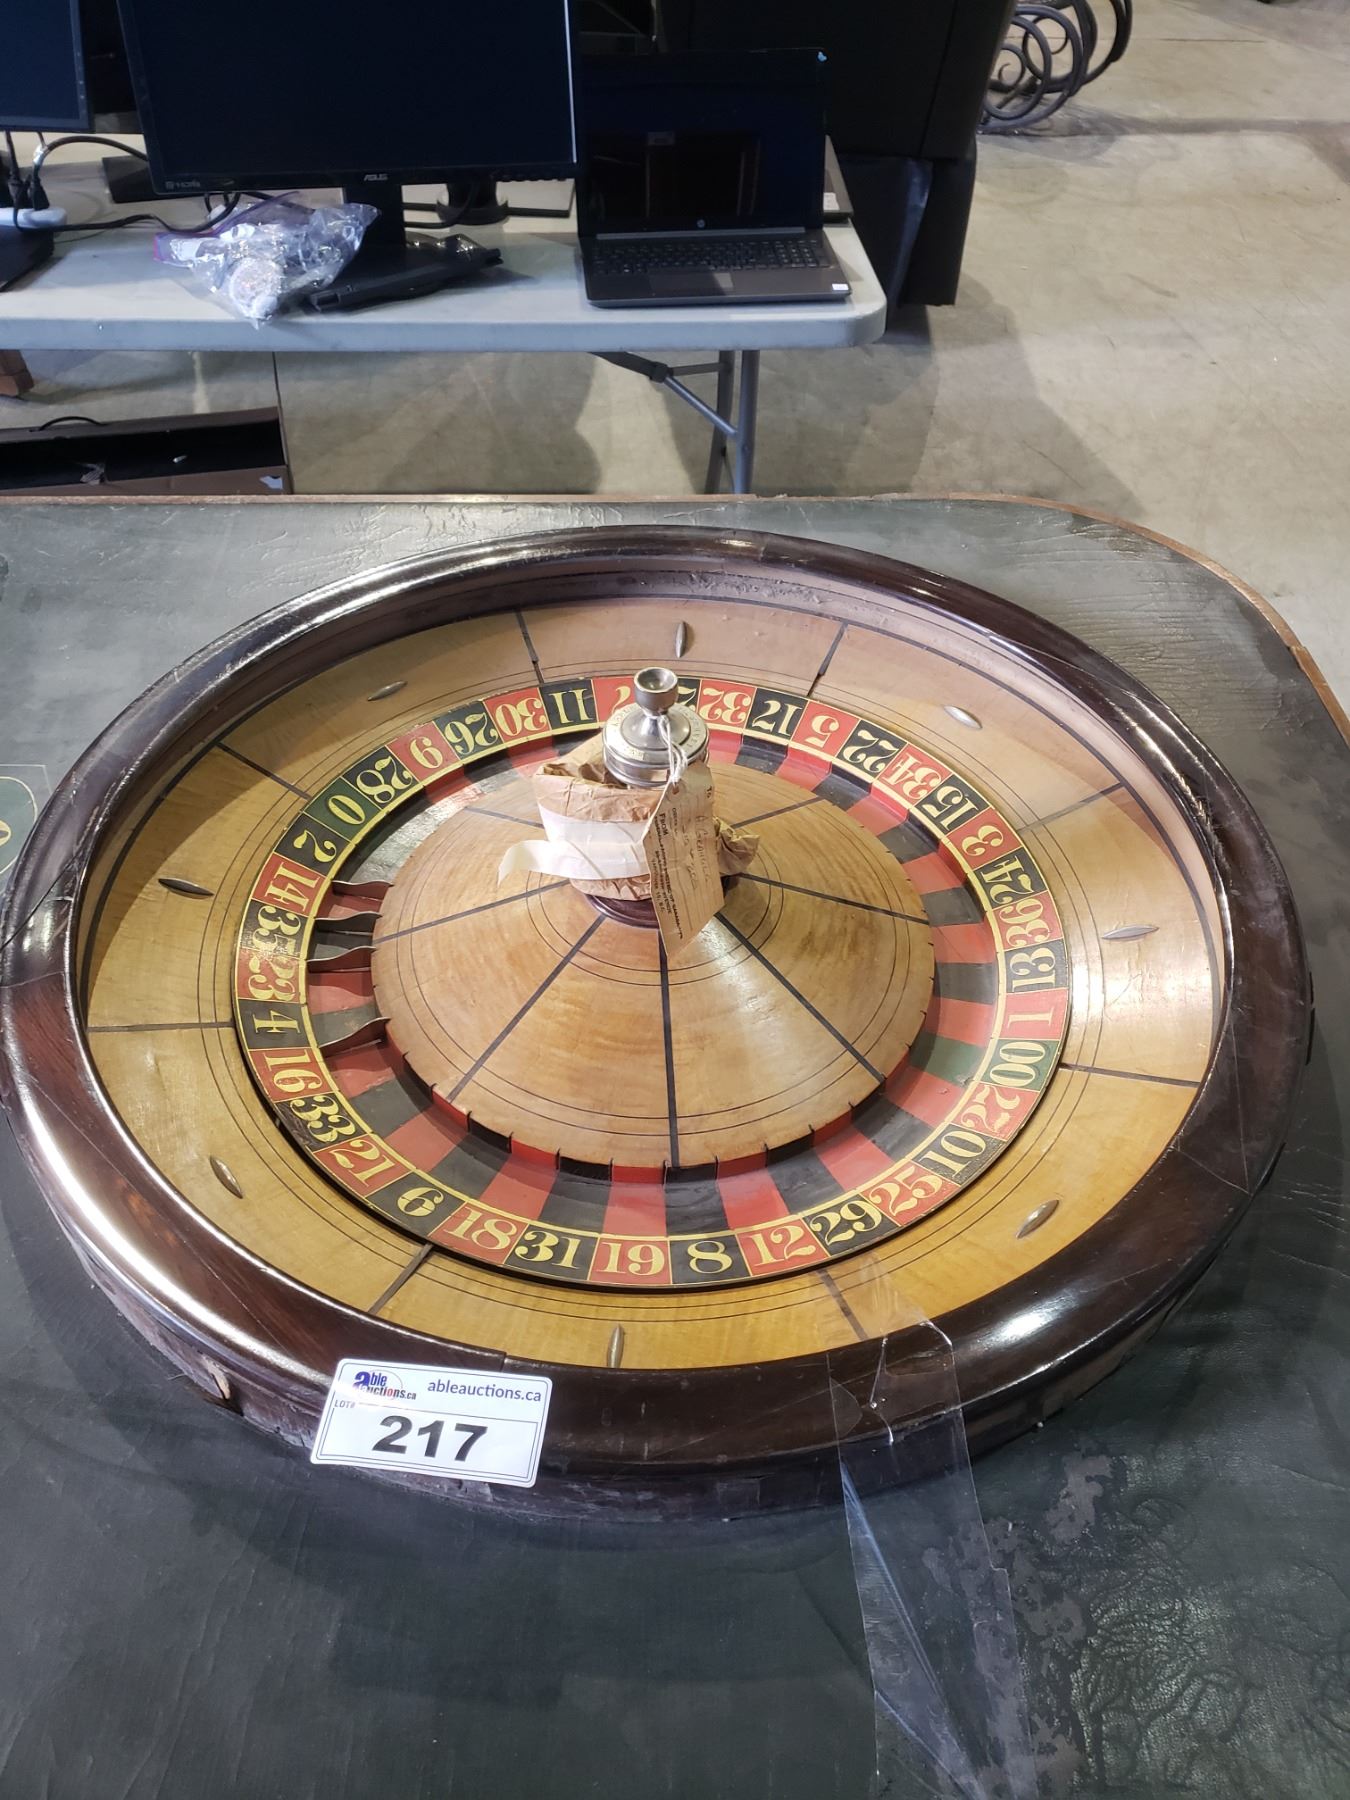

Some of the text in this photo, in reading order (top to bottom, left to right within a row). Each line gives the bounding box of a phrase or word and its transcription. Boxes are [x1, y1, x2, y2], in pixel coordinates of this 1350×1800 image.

[495, 697, 546, 736] 30
[552, 689, 593, 724] 11
[699, 687, 753, 724] 32
[752, 700, 803, 736] 17
[410, 737, 444, 769] 9
[444, 712, 499, 754] 26
[809, 715, 840, 748] 5
[843, 729, 900, 773] 22
[356, 756, 413, 804] 28
[881, 752, 942, 800] 34
[328, 795, 366, 825] 0
[659, 812, 669, 836] FROM
[922, 785, 979, 831] 15
[293, 830, 338, 863] 2
[961, 825, 1004, 857] 3
[264, 861, 322, 912] 14
[980, 855, 1035, 904] 24
[253, 905, 301, 957] 35
[1000, 898, 1050, 948] 36
[248, 951, 298, 1002] 23
[1010, 947, 1056, 992] 13
[253, 1010, 300, 1034] 4
[1007, 1005, 1055, 1028] 1
[263, 1049, 323, 1093] 16
[989, 1041, 1046, 1087] 00
[289, 1095, 356, 1143] 33
[961, 1084, 1021, 1134] 27
[328, 1139, 396, 1188] 21
[919, 1129, 987, 1178] 10
[397, 1187, 444, 1217] 6
[868, 1165, 943, 1217] 25
[443, 1206, 518, 1250] 18
[810, 1200, 883, 1245] 29
[514, 1230, 582, 1270] 31
[598, 1240, 666, 1276] 19
[686, 1240, 734, 1274] 8
[750, 1225, 817, 1266] 12
[333, 1400, 356, 1409] LOT#
[427, 1379, 542, 1402] ableauctions.ca
[371, 1415, 489, 1463] 217
